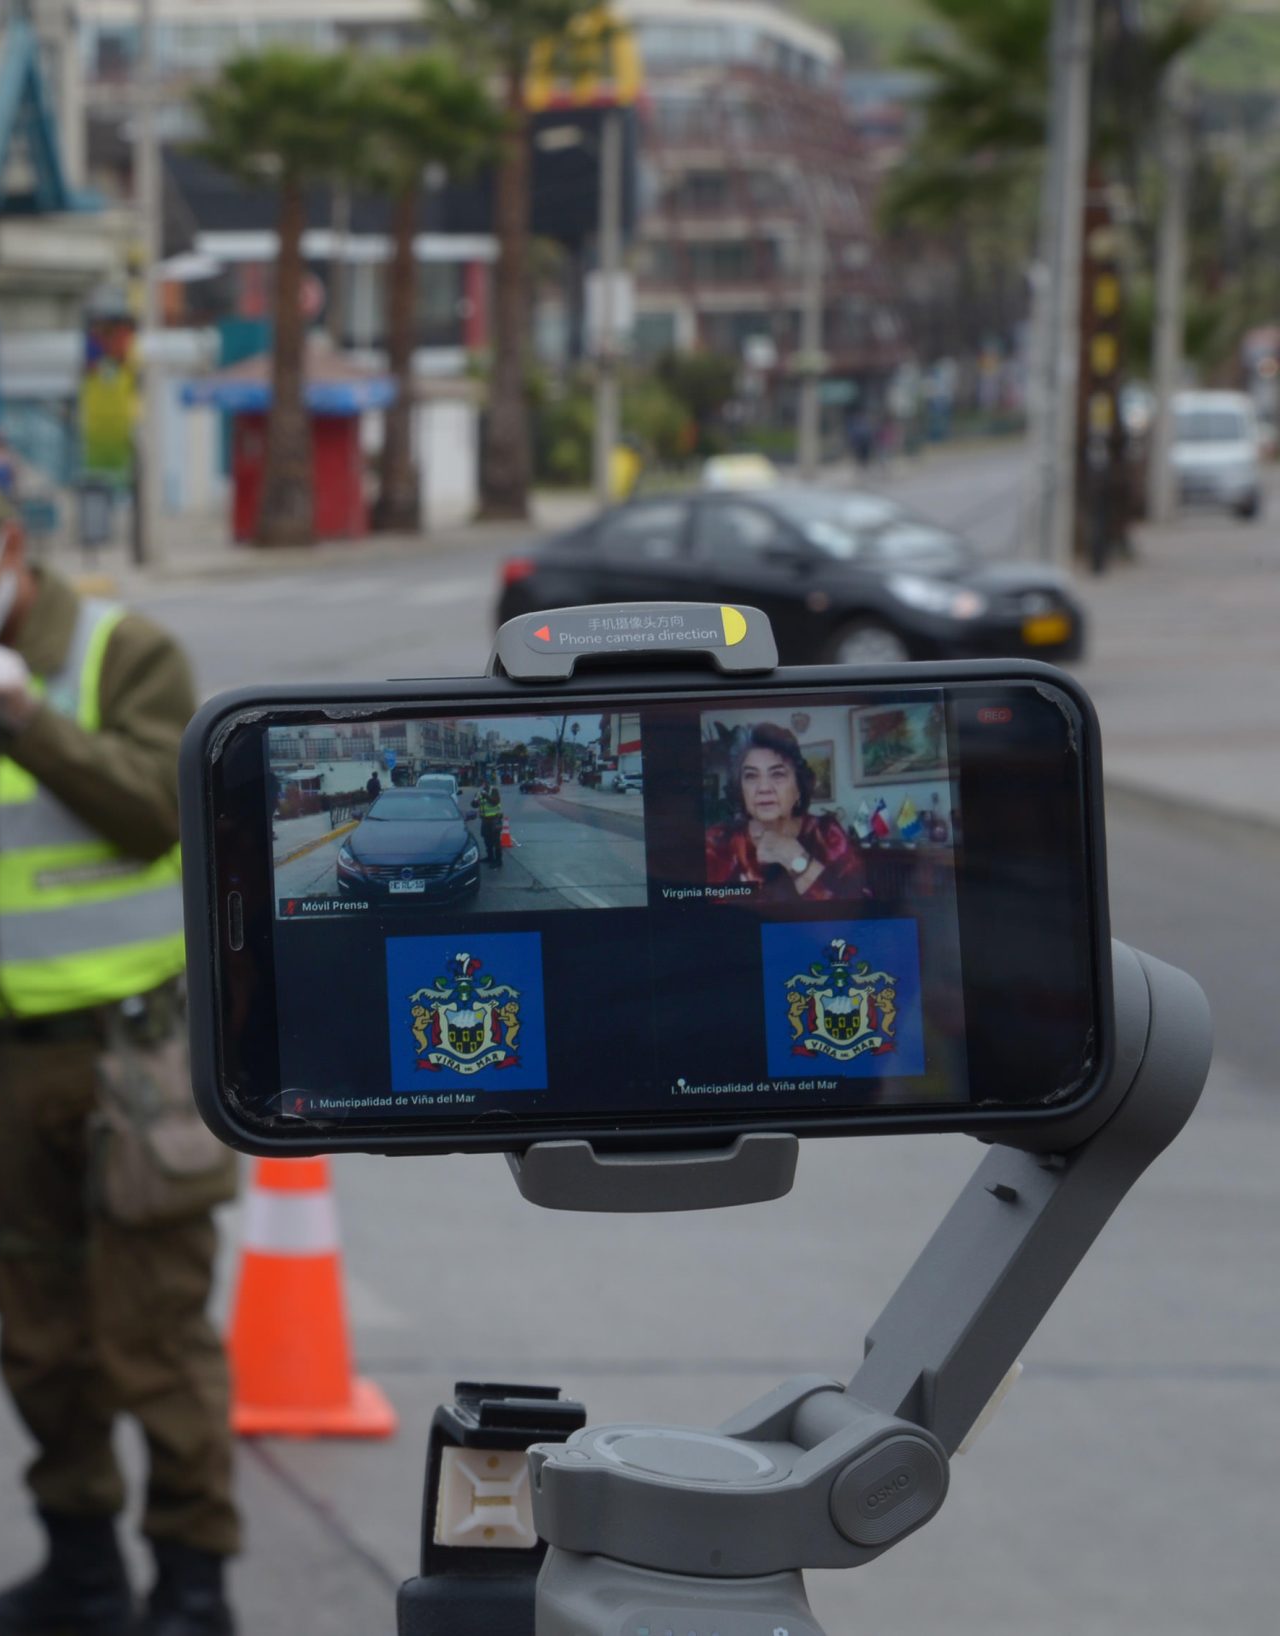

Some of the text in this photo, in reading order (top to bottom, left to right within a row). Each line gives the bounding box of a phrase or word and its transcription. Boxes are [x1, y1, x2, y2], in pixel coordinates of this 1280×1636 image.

[559, 629, 718, 645] Phone camera direction
[662, 886, 752, 899] Virginia Reginato
[302, 901, 369, 911] Móvil Prensa
[852, 1039, 876, 1054] MAR
[476, 1053, 499, 1069] MAR
[680, 1082, 754, 1095] Municipalidad
[756, 1082, 770, 1092] de
[773, 1081, 796, 1091] Viña
[798, 1080, 814, 1090] del
[817, 1080, 838, 1089] Mar
[320, 1096, 392, 1109] Municipalidad
[395, 1096, 408, 1105] de
[411, 1094, 434, 1105] Viña
[437, 1093, 453, 1104] del
[456, 1094, 476, 1103] Mar
[866, 1474, 910, 1508] OSMO
